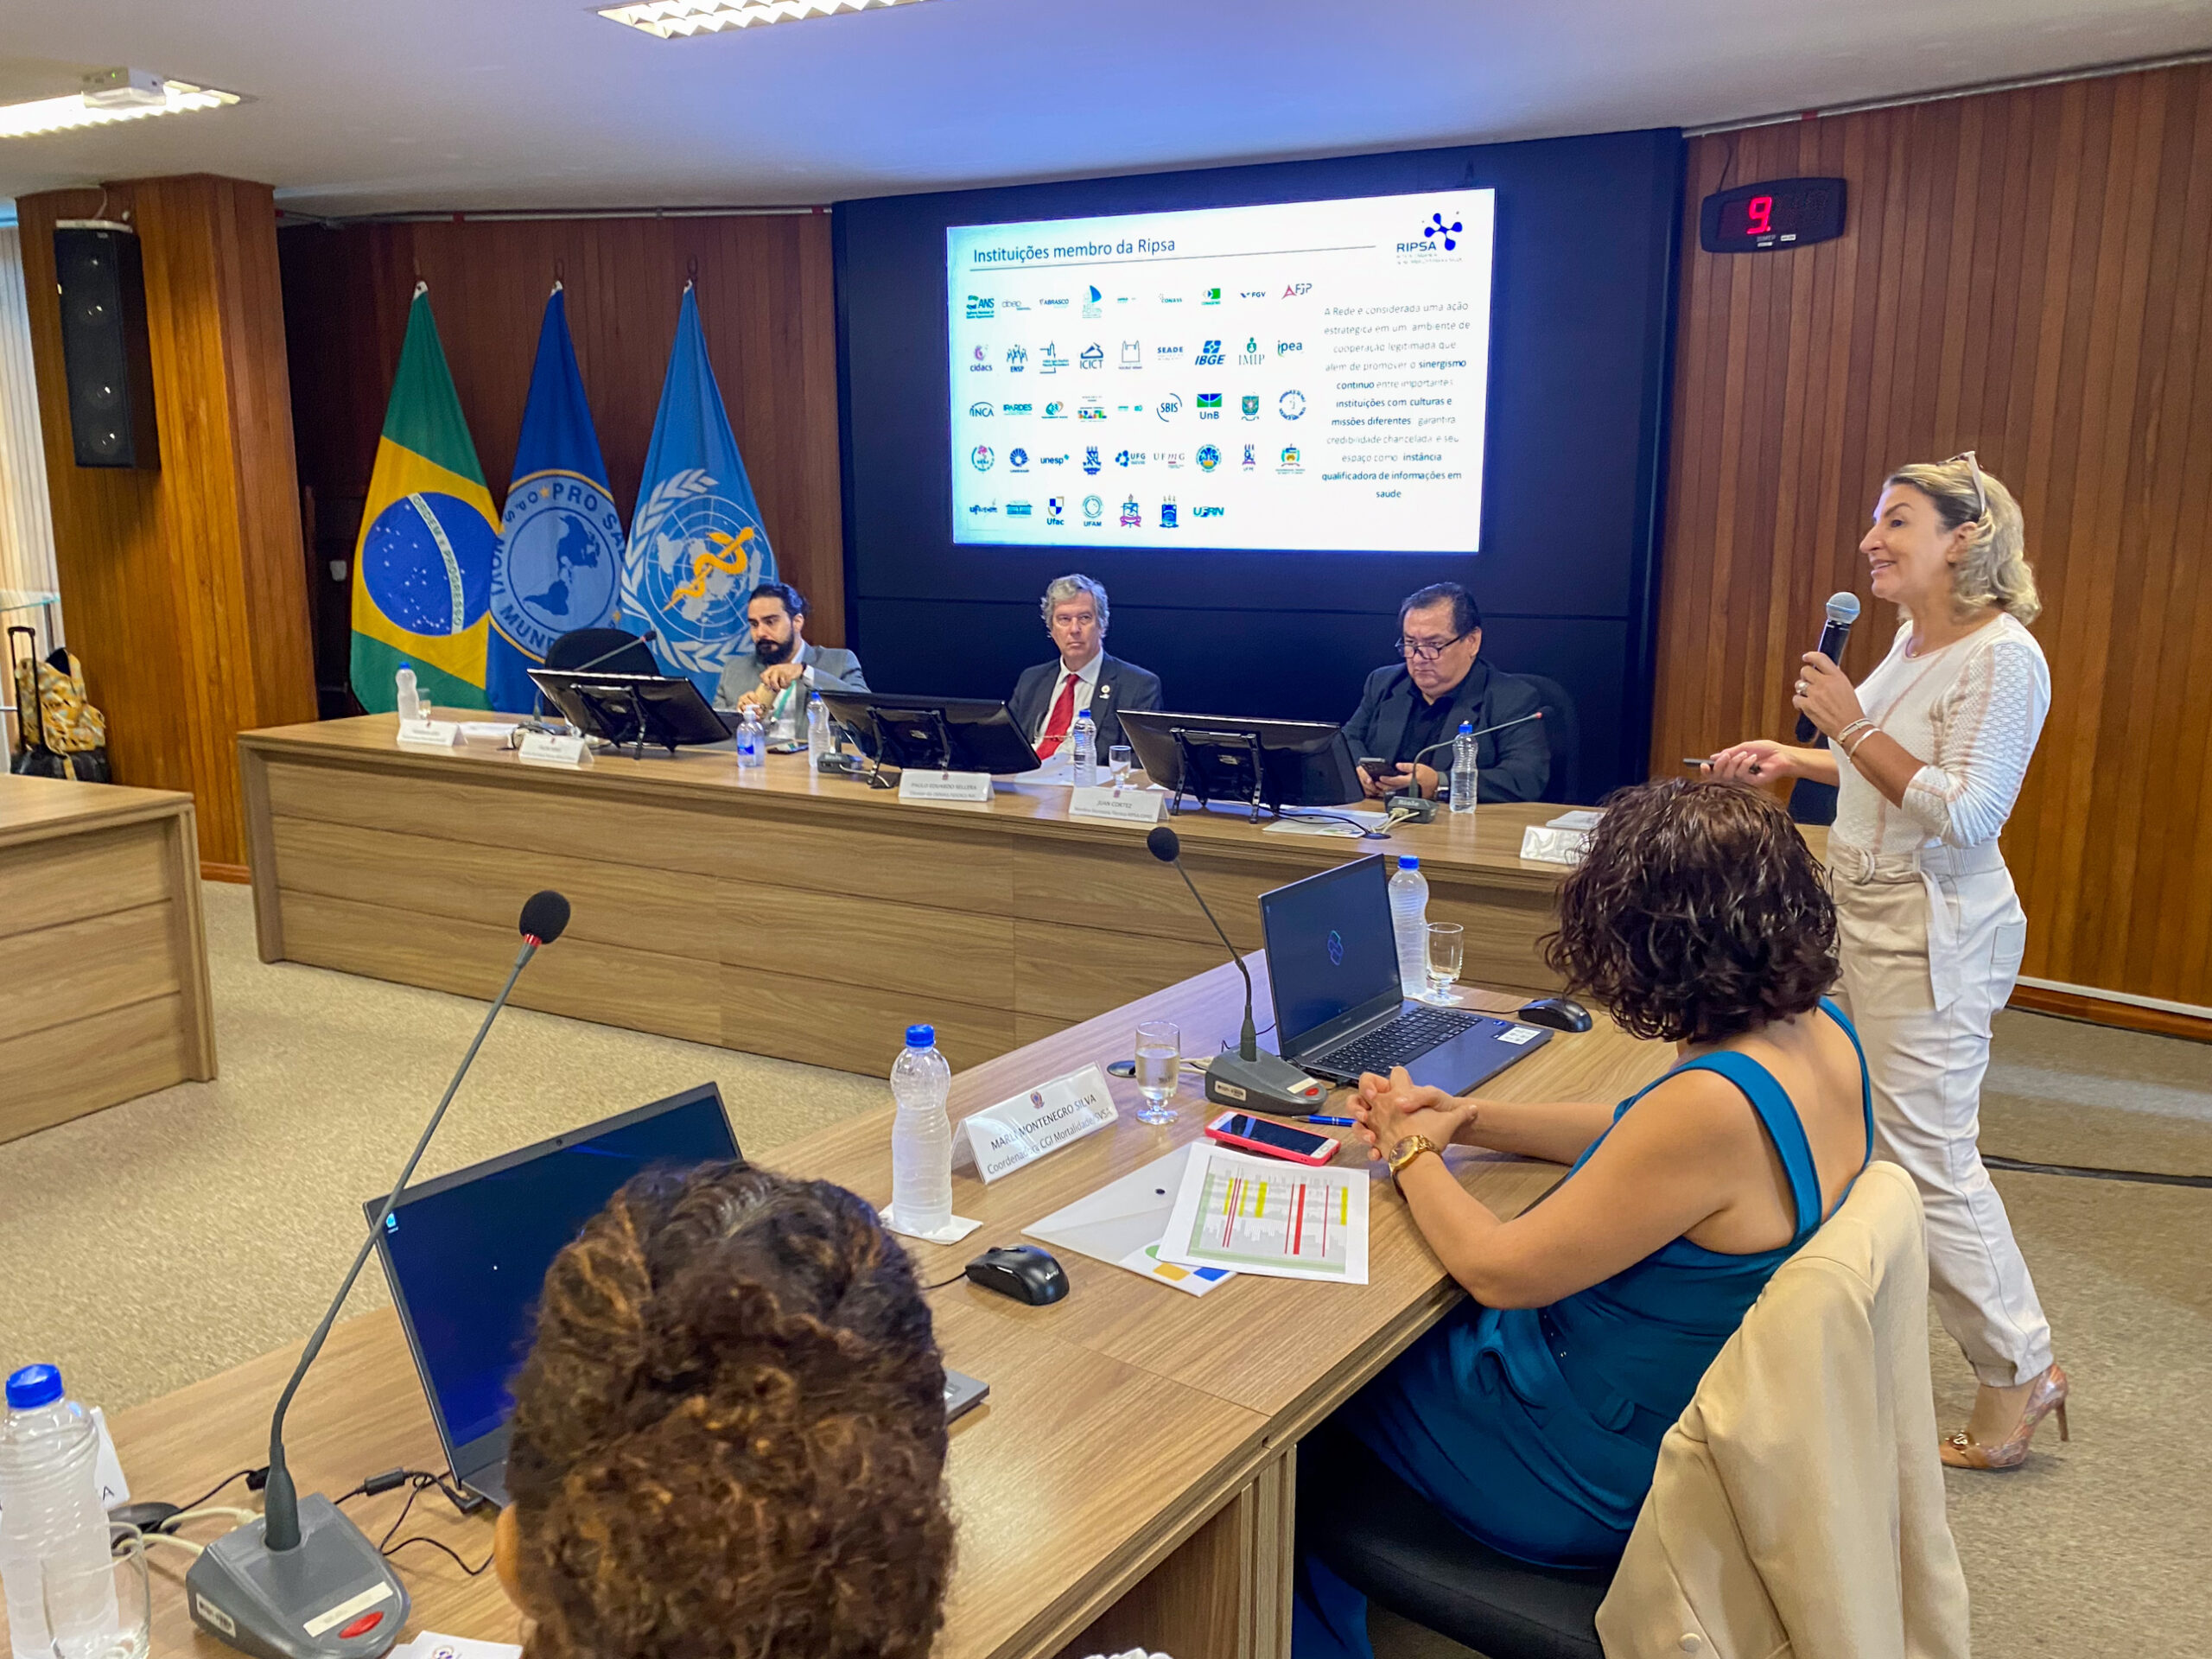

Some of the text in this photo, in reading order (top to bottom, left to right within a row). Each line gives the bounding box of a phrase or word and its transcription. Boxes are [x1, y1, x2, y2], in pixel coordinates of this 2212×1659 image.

[974, 238, 1175, 263] Instituições membro da Ripsa
[1396, 241, 1437, 252] RIPSA
[978, 298, 995, 308] ANS
[1333, 307, 1355, 315] Rede
[1365, 304, 1421, 315] considerada
[1446, 302, 1469, 312] ação
[1412, 321, 1456, 332] ambiente
[1459, 321, 1471, 330] de
[1277, 340, 1302, 353] ipea
[1388, 342, 1436, 353] legitimada
[1439, 342, 1457, 351] que
[1079, 359, 1103, 370] ICICT
[1195, 354, 1226, 365] IBGE
[1238, 354, 1265, 365] IMIP
[1350, 361, 1361, 371] de
[1363, 362, 1407, 372] promover
[1419, 359, 1466, 370] sinergismo
[1160, 402, 1179, 413] SBIS
[1336, 398, 1385, 409] instituições
[1409, 397, 1445, 406] culturas
[1199, 411, 1219, 420] UnB
[1332, 417, 1365, 426] missões
[1367, 416, 1411, 425] diferentes
[1040, 457, 1064, 466] unesp
[1342, 454, 1371, 464] espaço
[1403, 452, 1441, 461] instância
[1321, 471, 1376, 481] qualificadora
[1391, 471, 1446, 481] informações
[553, 483, 598, 512] PRO
[1074, 1094, 1097, 1111] SILVA
[1039, 1133, 1055, 1149] CGI
